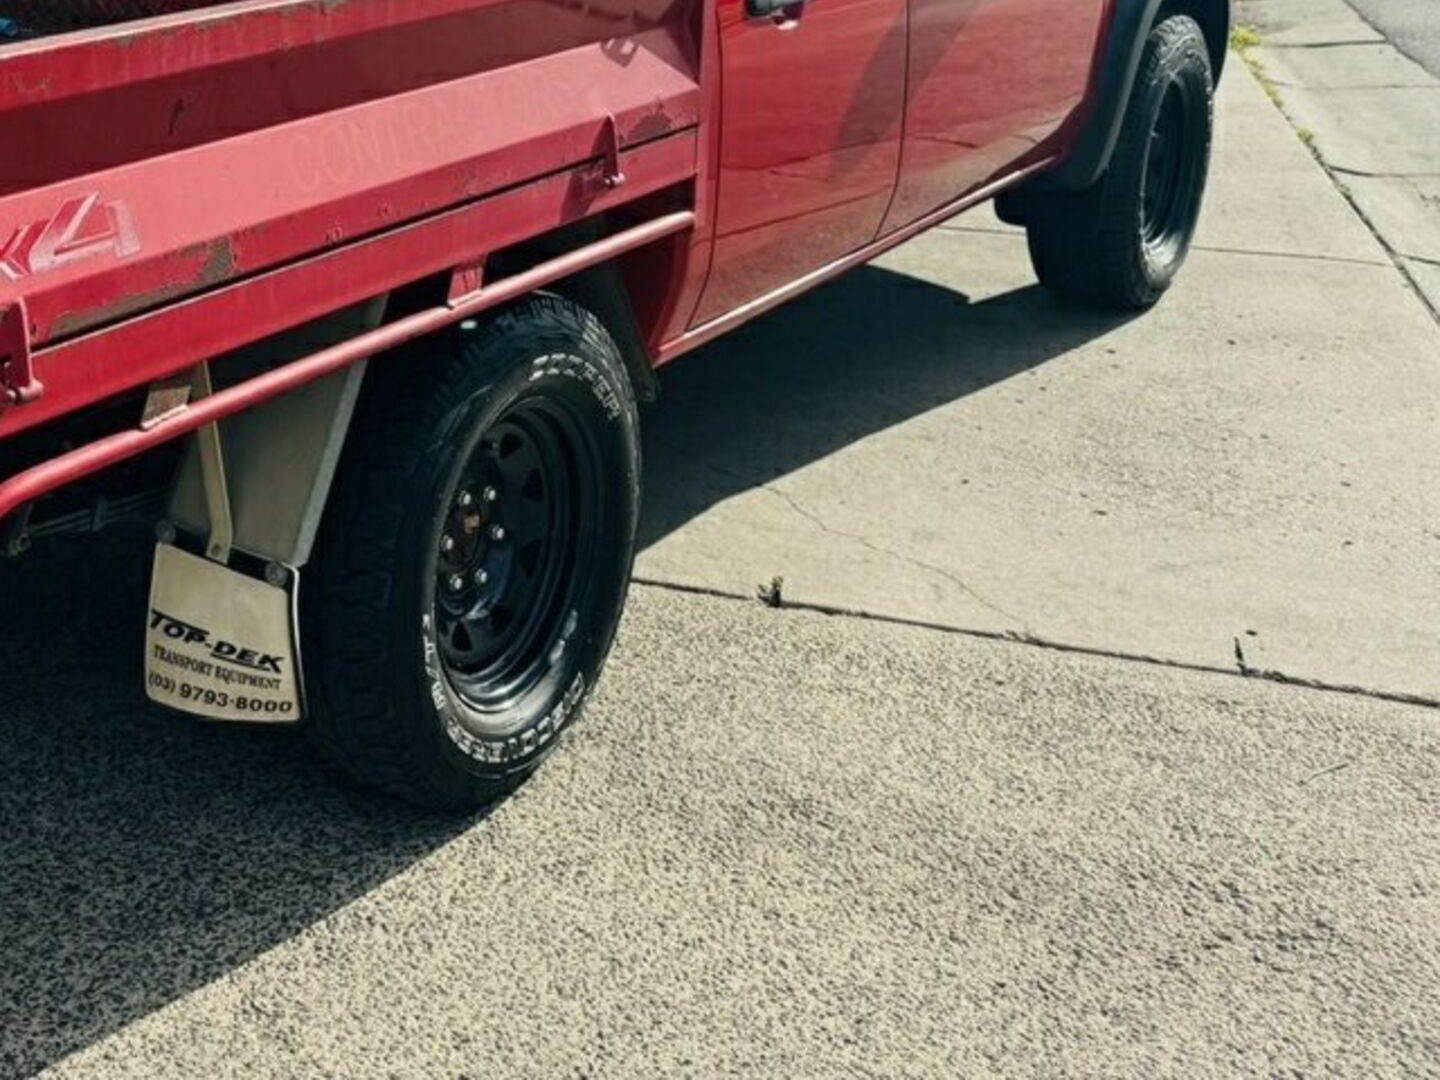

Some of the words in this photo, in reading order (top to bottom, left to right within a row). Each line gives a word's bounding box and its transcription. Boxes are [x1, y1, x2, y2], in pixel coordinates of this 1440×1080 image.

[149, 609, 285, 674] TOP-DEK
[148, 671, 176, 694] (03)
[154, 645, 213, 678] TRANSPORT
[214, 665, 283, 691] EQUIPMENT
